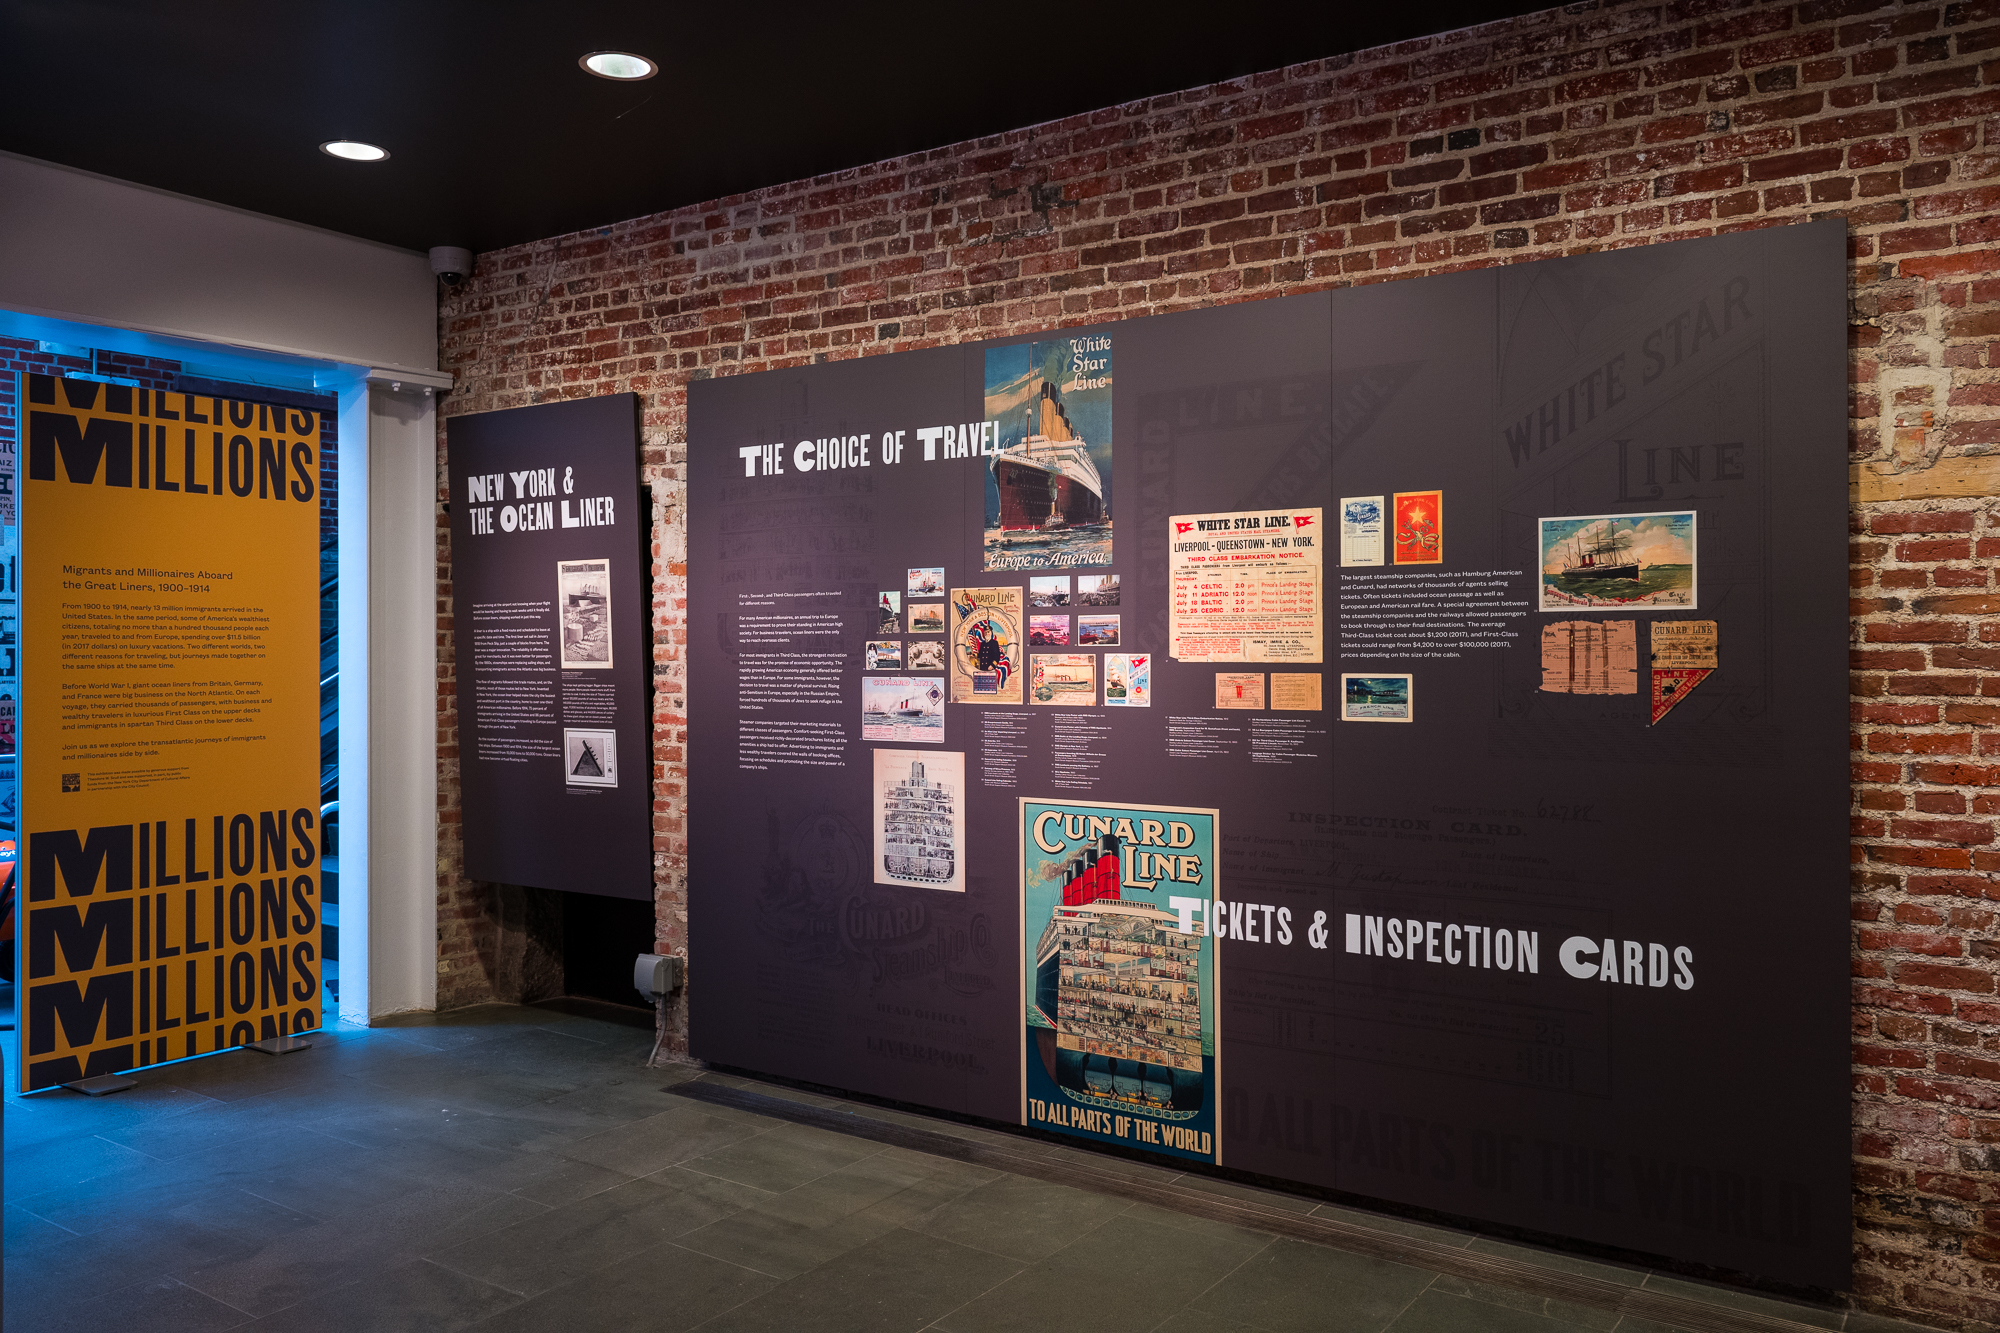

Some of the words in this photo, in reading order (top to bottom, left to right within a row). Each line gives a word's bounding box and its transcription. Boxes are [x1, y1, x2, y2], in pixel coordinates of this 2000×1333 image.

[1070, 336, 1112, 354] White
[1072, 354, 1108, 372] Star
[1502, 352, 1626, 468] WHITE
[1642, 275, 1754, 387] STAR
[1072, 372, 1106, 392] Line
[29, 410, 314, 502] MILLIONS
[740, 443, 784, 477] THE
[794, 434, 870, 472] CHOICE
[882, 430, 906, 464] OF
[917, 421, 1004, 461] TRAVEL
[468, 474, 504, 503] NEW
[509, 468, 556, 498] YORK
[562, 466, 574, 494] &
[1612, 439, 1744, 503] LINE
[470, 507, 494, 535] THE
[500, 502, 554, 532] OCEAN
[561, 496, 614, 528] LINER
[1197, 519, 1230, 532] WHITE
[1234, 517, 1261, 530] STAR
[1265, 516, 1290, 528] LINE.
[1293, 536, 1314, 547] YORK.
[62, 564, 112, 577] Migrants
[114, 568, 134, 576] and
[137, 568, 195, 579] Millionaires
[197, 570, 233, 580] Aboard
[989, 554, 1030, 571] Europe
[1033, 557, 1044, 566] to
[1046, 551, 1107, 566] America.
[62, 580, 82, 590] the
[84, 580, 117, 591] Great
[119, 582, 157, 593] Liners,
[159, 583, 210, 593] 1900–1914
[962, 592, 996, 606] CUNARD
[998, 592, 1016, 604] LINE
[61, 602, 82, 612] From
[112, 603, 131, 611] 1914,
[184, 605, 221, 613] immigrants
[61, 612, 87, 622] United
[1654, 626, 1688, 634] CUNARD
[1033, 810, 1195, 854] CUNARD
[1288, 812, 1431, 831] INSPECTION
[1451, 822, 1528, 836] CARD.
[29, 808, 316, 902] MILLIONS
[1122, 845, 1202, 892] LINE
[29, 874, 316, 980] MILLIONS
[1170, 896, 1292, 946] TICKETS
[1308, 910, 1328, 949] &
[1345, 914, 1539, 974] INSPECTION
[1559, 936, 1694, 990] CARDS
[29, 941, 316, 1056] MILLIONS
[1029, 1098, 1046, 1121] TO
[1048, 1102, 1070, 1126] ALL
[1071, 1106, 1112, 1134] PARTS
[1115, 1115, 1130, 1138] OF
[1134, 1118, 1160, 1144] THE
[1161, 1124, 1212, 1155] WORLD
